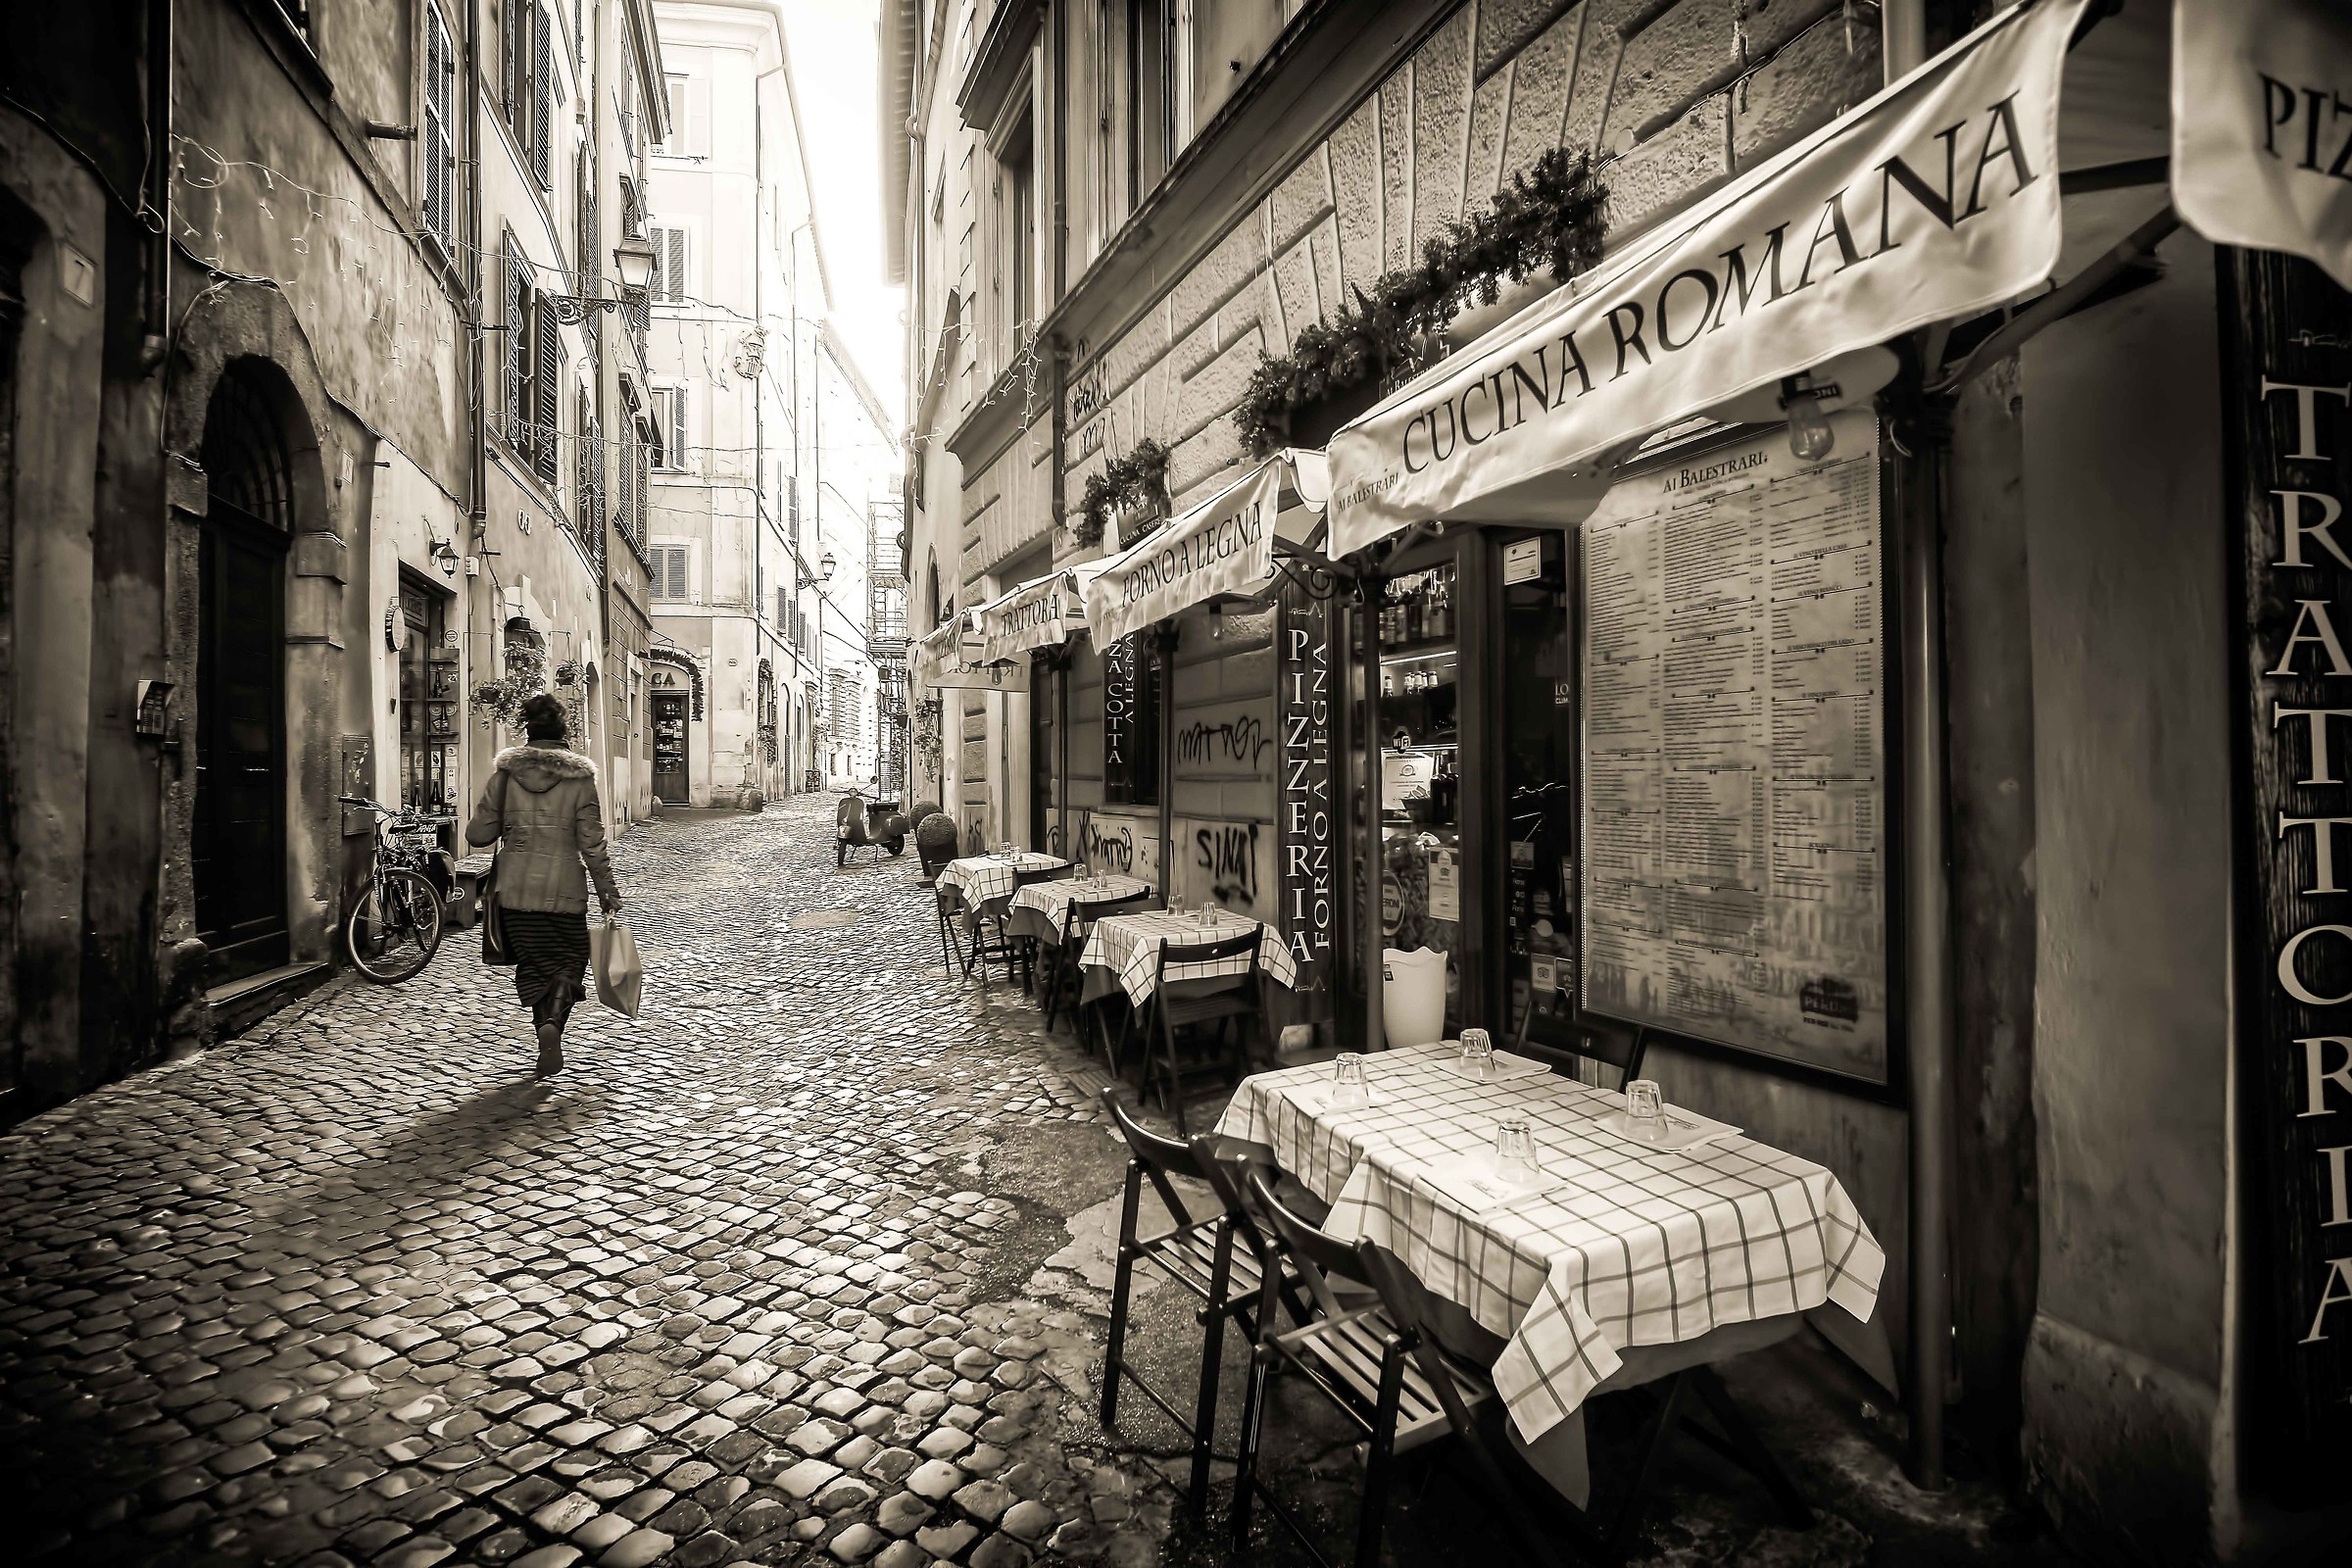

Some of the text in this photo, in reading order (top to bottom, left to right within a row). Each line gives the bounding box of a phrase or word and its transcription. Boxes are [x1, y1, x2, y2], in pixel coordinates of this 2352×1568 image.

[1402, 91, 2039, 474] CUCINA ROMANA
[1347, 472, 1398, 508] BALESTRARI
[1680, 452, 1763, 488] BALESTRARI
[1122, 501, 1262, 608] FORNO A LEGNA
[1106, 683, 1124, 763] COTTA
[1286, 628, 1314, 962] PIZZERIA
[1312, 642, 1330, 949] FORNO A LEGNA
[1383, 897, 1400, 908] ERONI
[2260, 374, 2352, 1345] TRATTORIA
